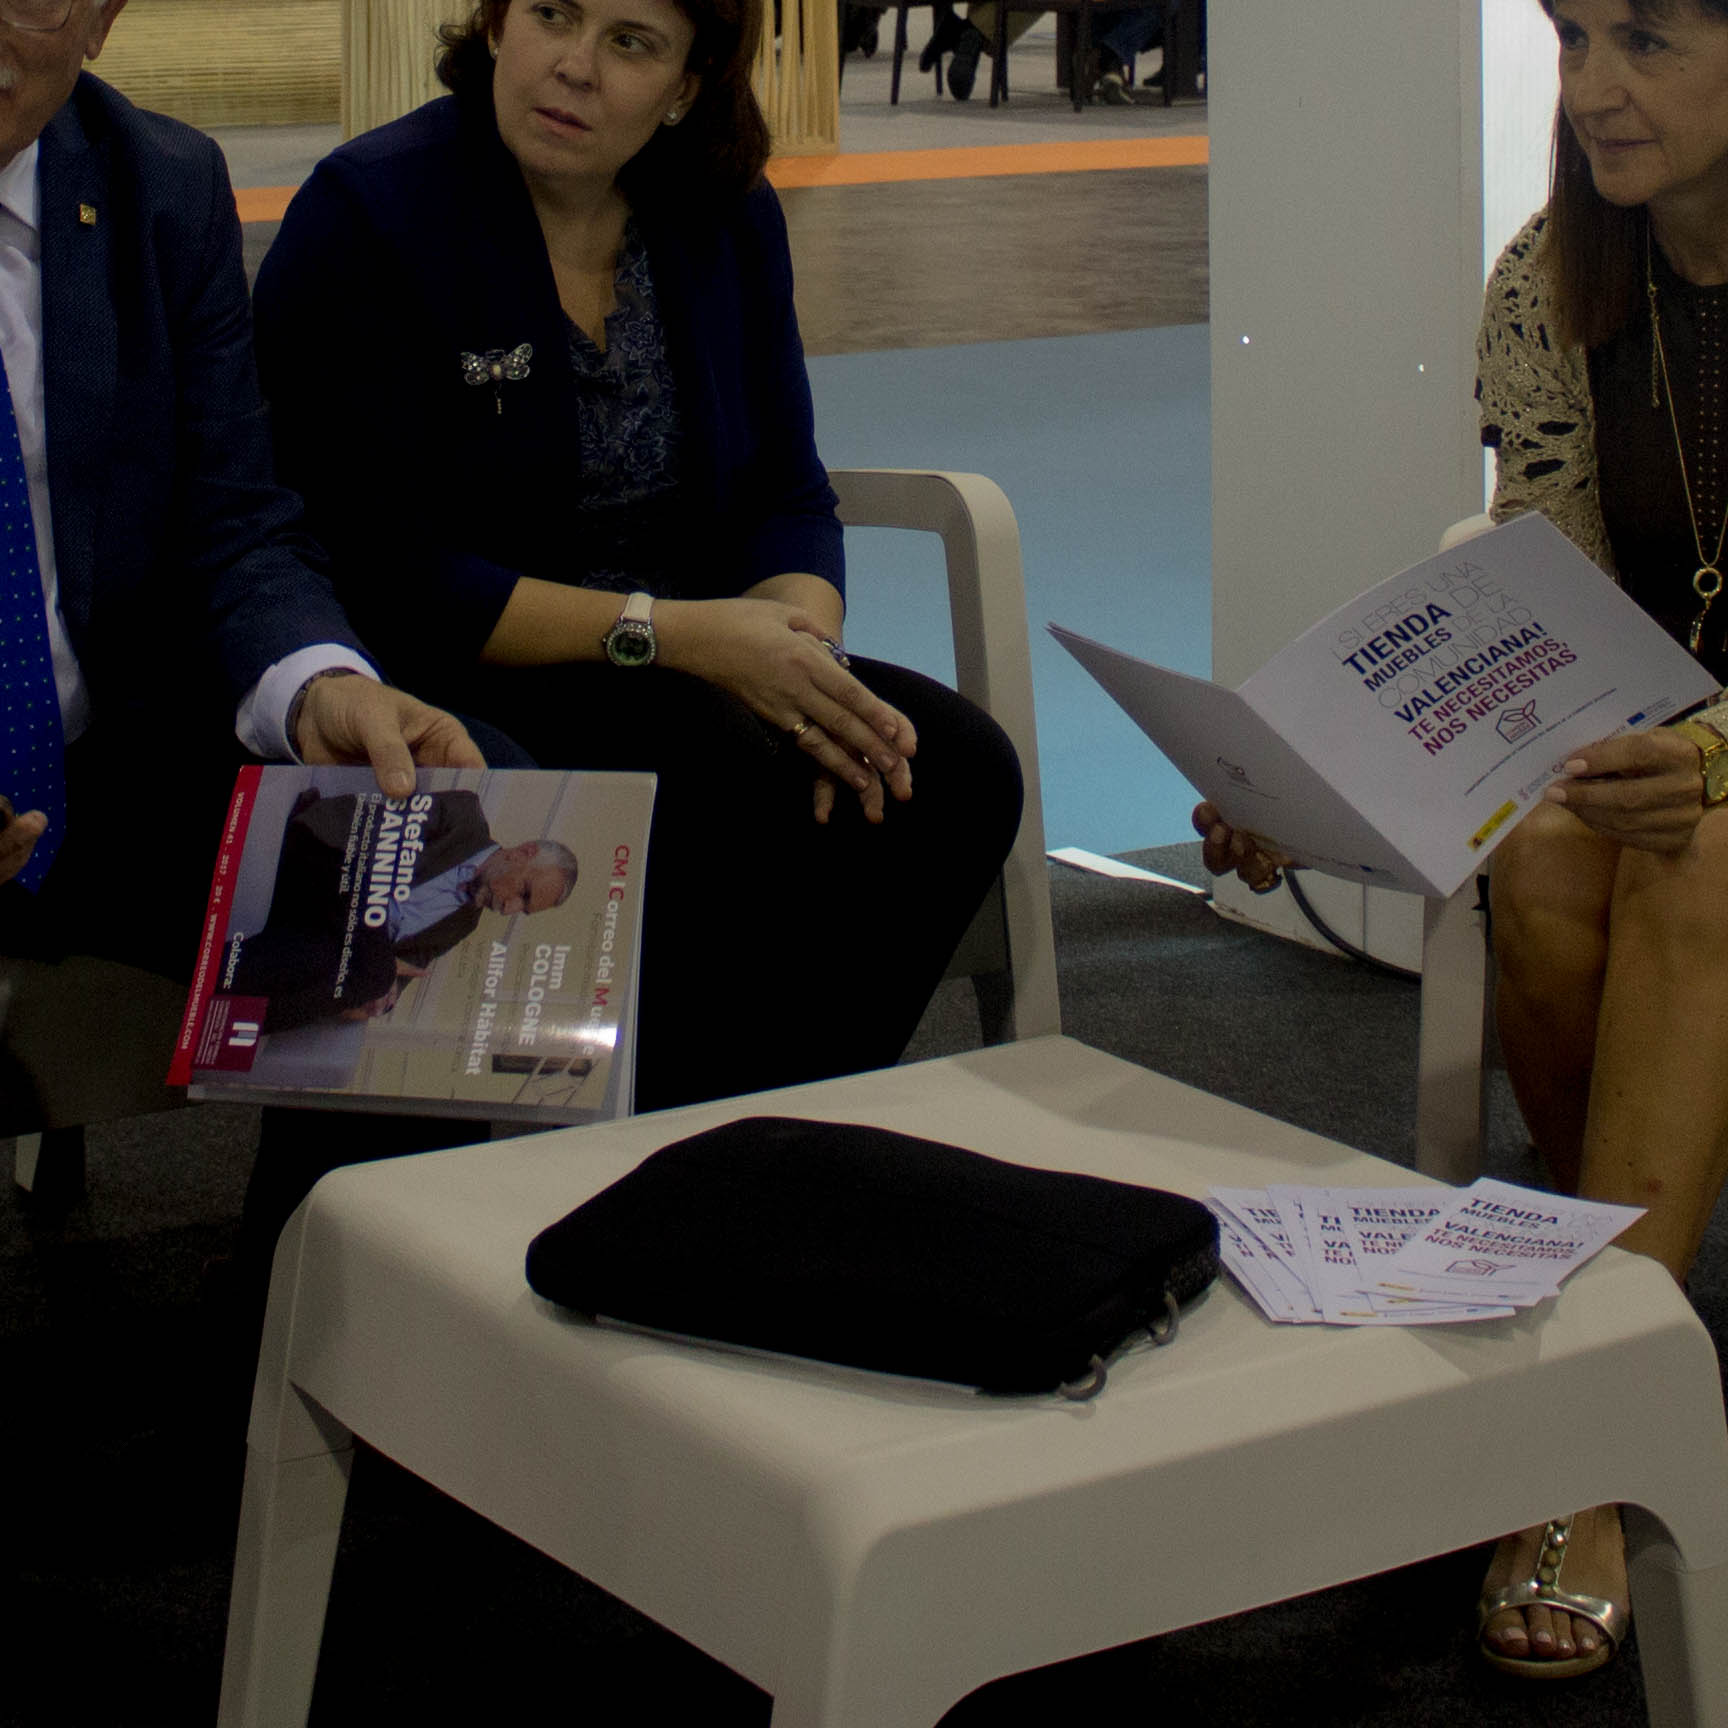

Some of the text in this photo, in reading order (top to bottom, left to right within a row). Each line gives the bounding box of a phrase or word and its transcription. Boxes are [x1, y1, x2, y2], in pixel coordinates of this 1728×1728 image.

[1342, 602, 1453, 676] TIENDA
[1363, 627, 1453, 693] MUEBLES
[1378, 606, 1534, 709] COMUNIDAD
[1394, 621, 1549, 724] VALENCIANA!
[1408, 717, 1436, 742] TE
[1433, 638, 1569, 723] NECESITAMOS,
[1422, 717, 1468, 757] NOS
[1466, 649, 1578, 723] NECESITAS
[364, 797, 409, 929] SANNINO
[393, 792, 433, 904] Stefano
[612, 844, 631, 877] CM
[482, 940, 509, 999] Allfor
[518, 944, 553, 1047] COLOGNE
[595, 955, 616, 985] del
[1425, 1234, 1464, 1250] NOS
[1444, 1221, 1585, 1248] VALENCIANA!
[1460, 1207, 1541, 1230] MUEBLES
[1471, 1198, 1559, 1225] TIENDA
